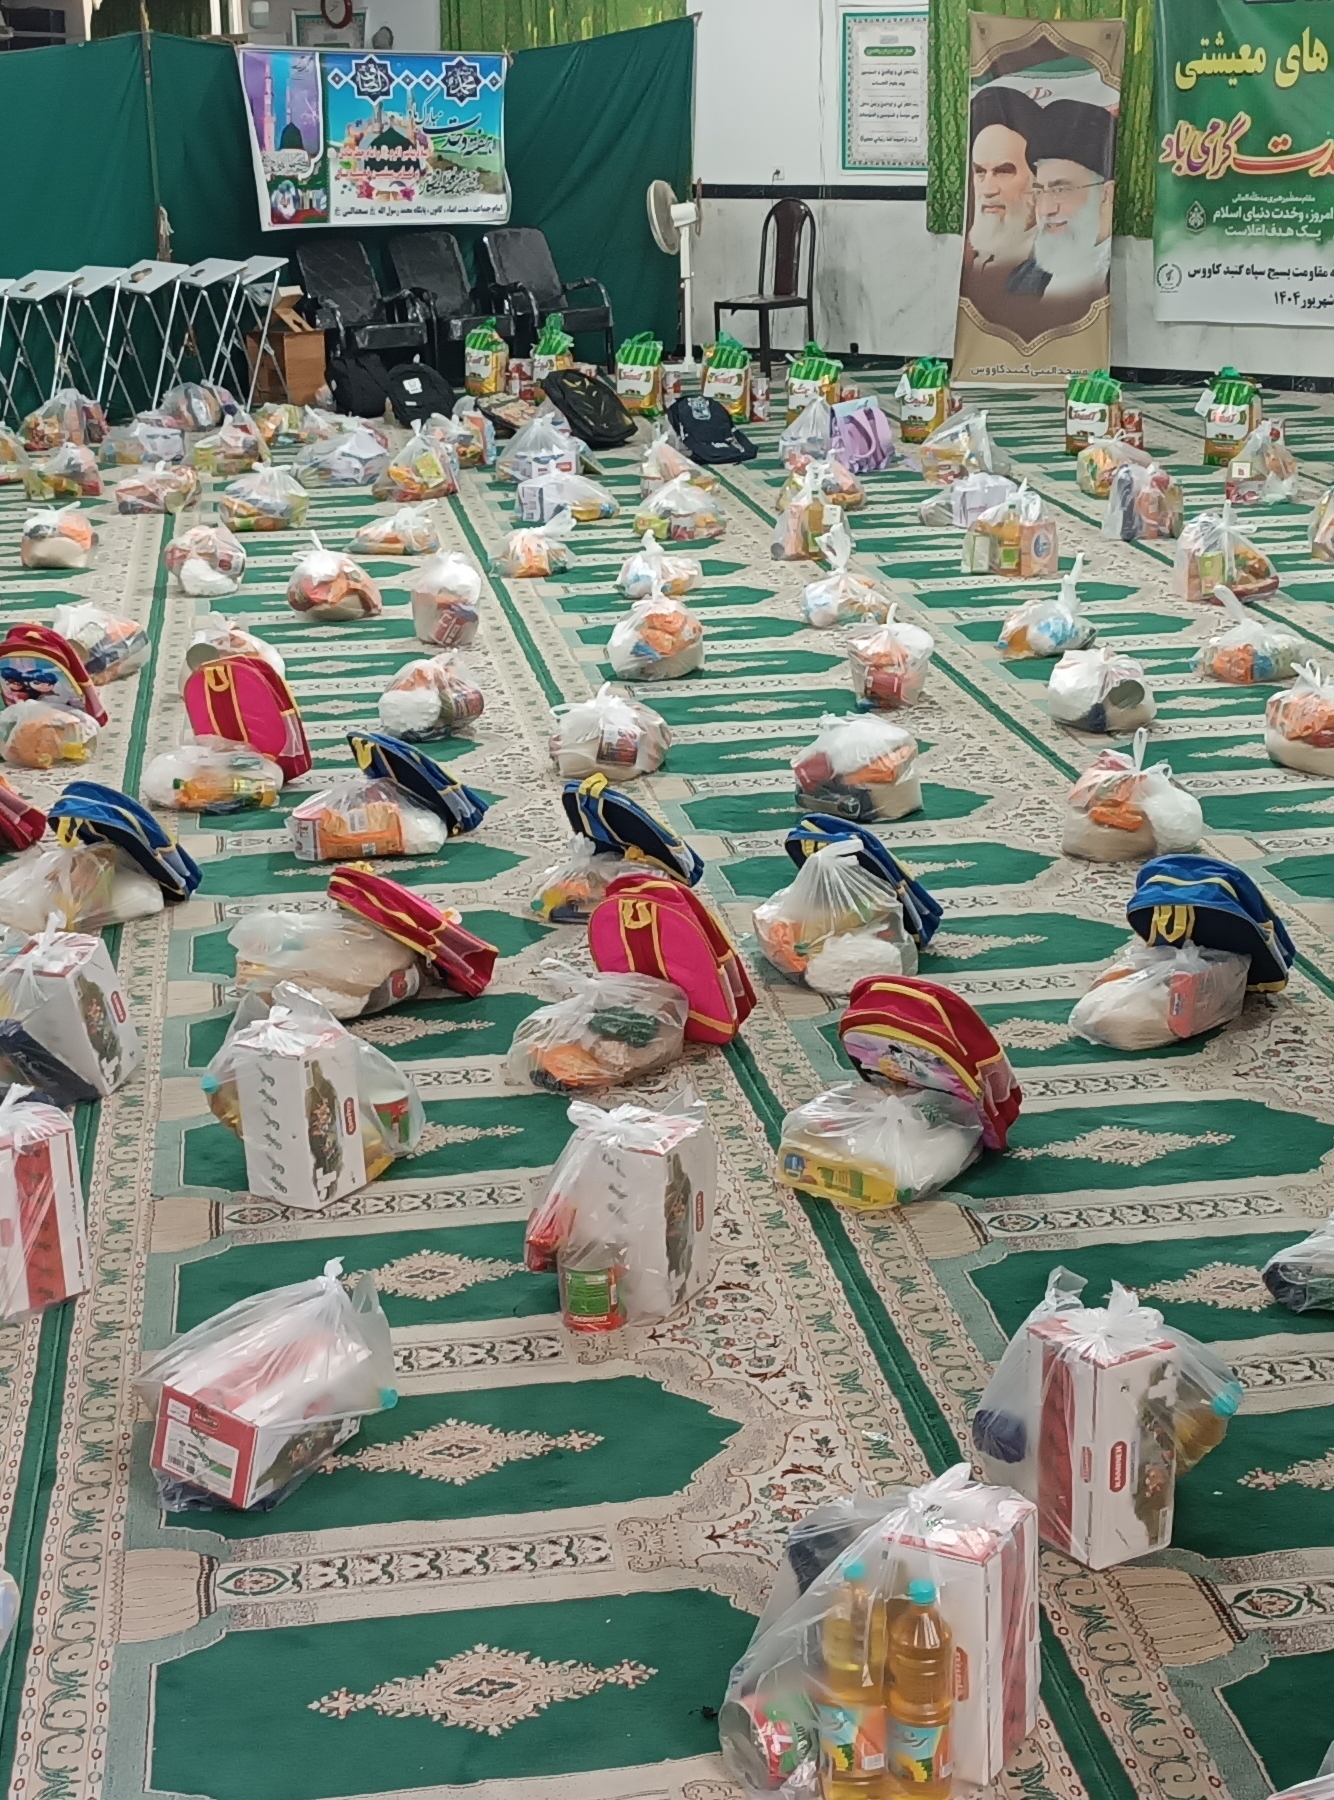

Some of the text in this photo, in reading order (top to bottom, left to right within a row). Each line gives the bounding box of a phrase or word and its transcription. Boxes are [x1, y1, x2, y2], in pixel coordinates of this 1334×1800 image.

[1174, 31, 1267, 90] معیشتی
[1274, 27, 1329, 87] های
[463, 127, 494, 156] هفته
[1159, 120, 1193, 175] باد
[1186, 112, 1251, 179] گرامی
[1212, 205, 1243, 224] اسلام
[1242, 206, 1271, 222] دنیای
[1224, 223, 1266, 237] اعلاست
[1265, 223, 1295, 237] هدف
[1186, 263, 1222, 279] کاووس
[1223, 263, 1245, 279] گنبد
[1244, 263, 1266, 282] سپاه
[1266, 264, 1292, 280] بسیج
[1291, 265, 1329, 281] مقاومت
[1273, 290, 1334, 309] شهریور ۱۴۰۴
[970, 364, 1005, 377] کاووس
[1005, 364, 1031, 375] گنبد
[1057, 366, 1088, 376] مسجد
[1113, 1444, 1123, 1489] KAMINEH
